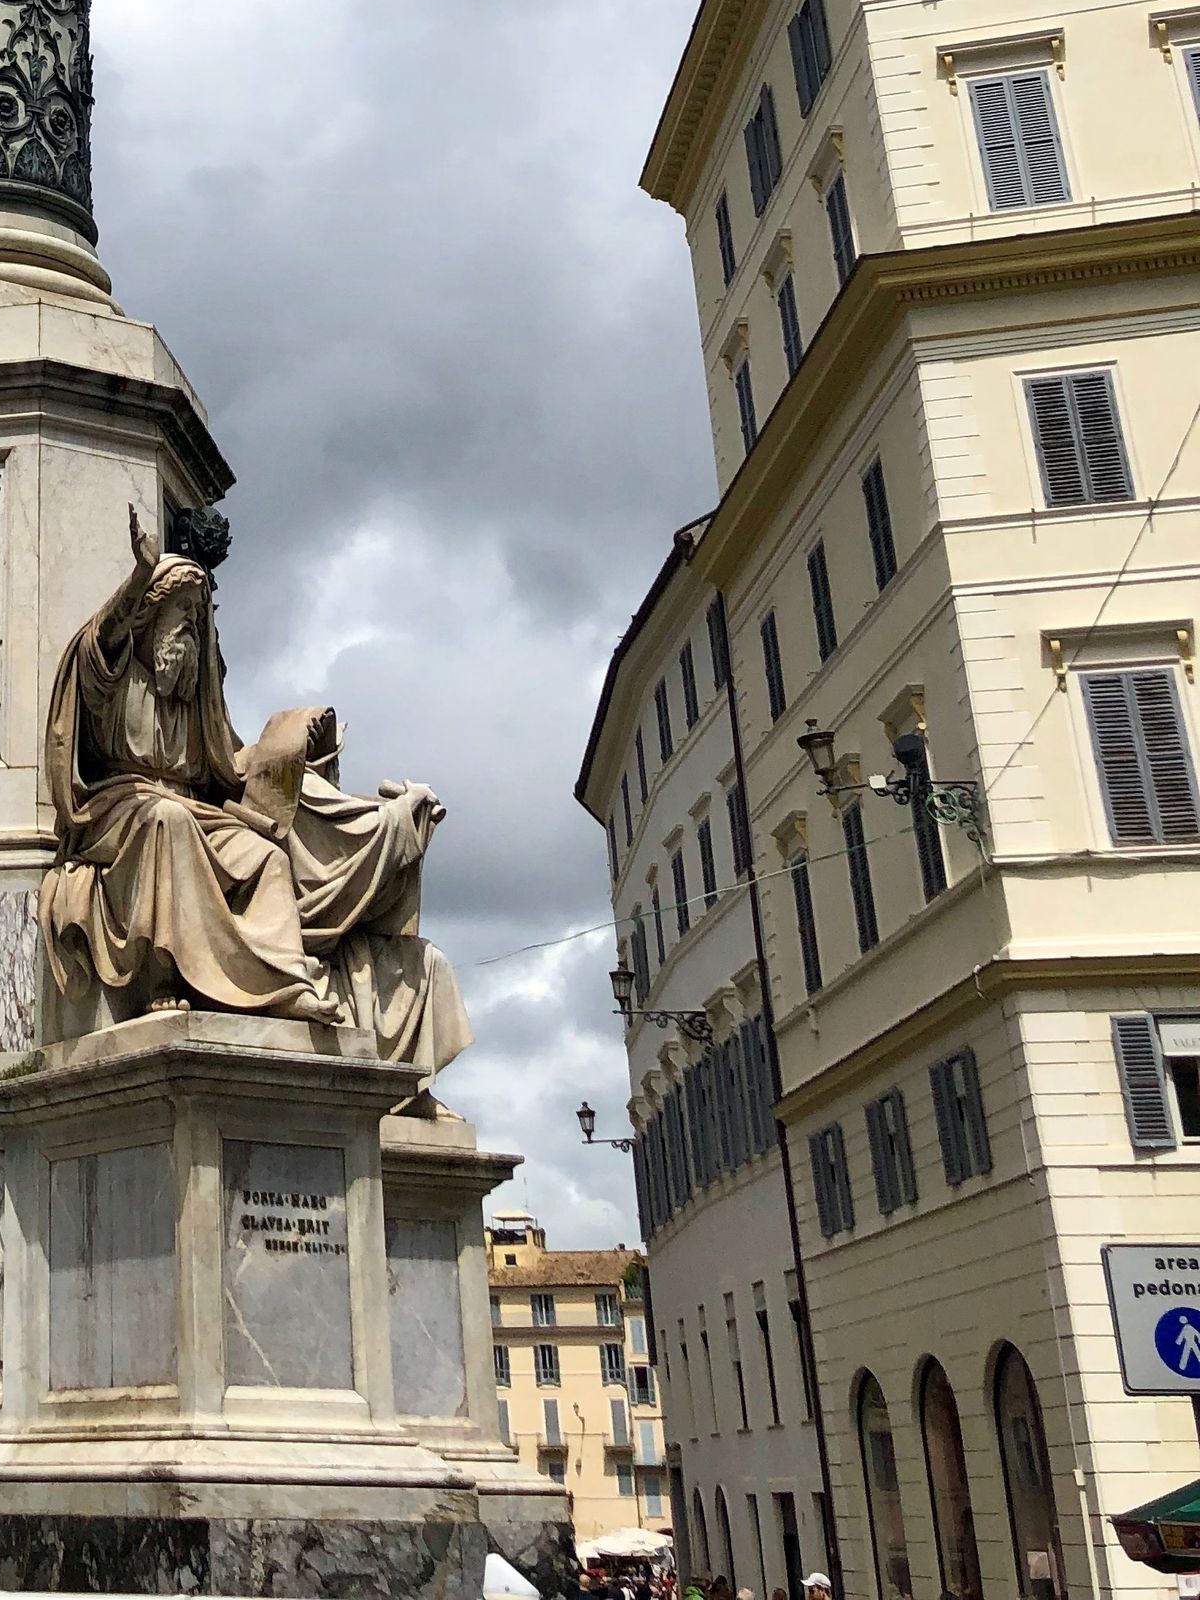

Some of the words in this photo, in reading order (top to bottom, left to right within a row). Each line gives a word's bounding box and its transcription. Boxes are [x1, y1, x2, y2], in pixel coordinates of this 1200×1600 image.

[243, 1191, 284, 1206] PORTA
[1154, 1257, 1200, 1270] area
[1132, 1279, 1200, 1298] pedon
